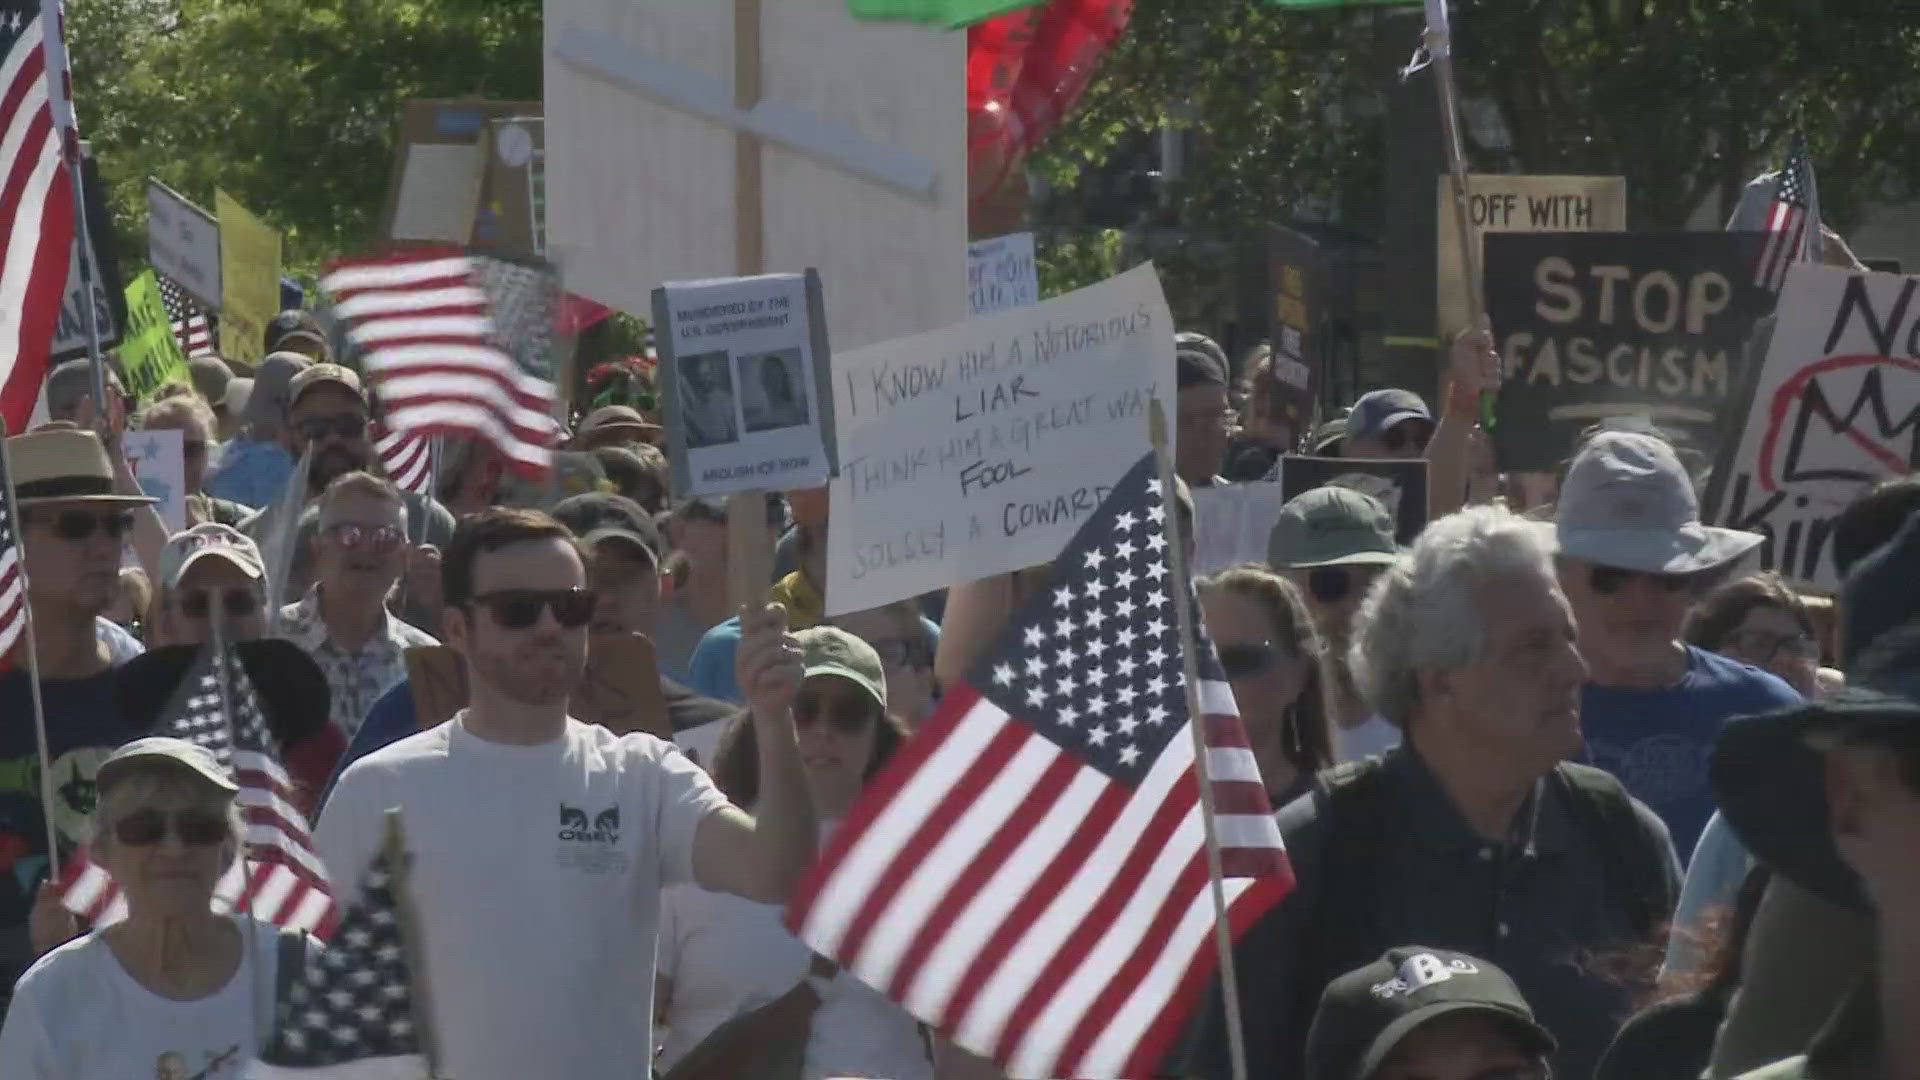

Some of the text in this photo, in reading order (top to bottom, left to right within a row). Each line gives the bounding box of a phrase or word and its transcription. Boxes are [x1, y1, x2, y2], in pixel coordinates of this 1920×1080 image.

[1470, 193, 1593, 227] OFF WITH
[1534, 255, 1732, 335] STOP
[845, 369, 857, 417] I
[871, 357, 947, 417] KNOW
[1006, 337, 1023, 366] A
[1502, 331, 1729, 397] FASCISM
[955, 374, 1040, 424] LIAR
[841, 444, 929, 504] THINK
[938, 427, 983, 473] HIM
[1010, 392, 1098, 456] GREAT
[1106, 379, 1158, 421] WAY
[959, 458, 1033, 497] FOOL
[966, 513, 985, 544] A
[558, 829, 620, 846] OBEY
